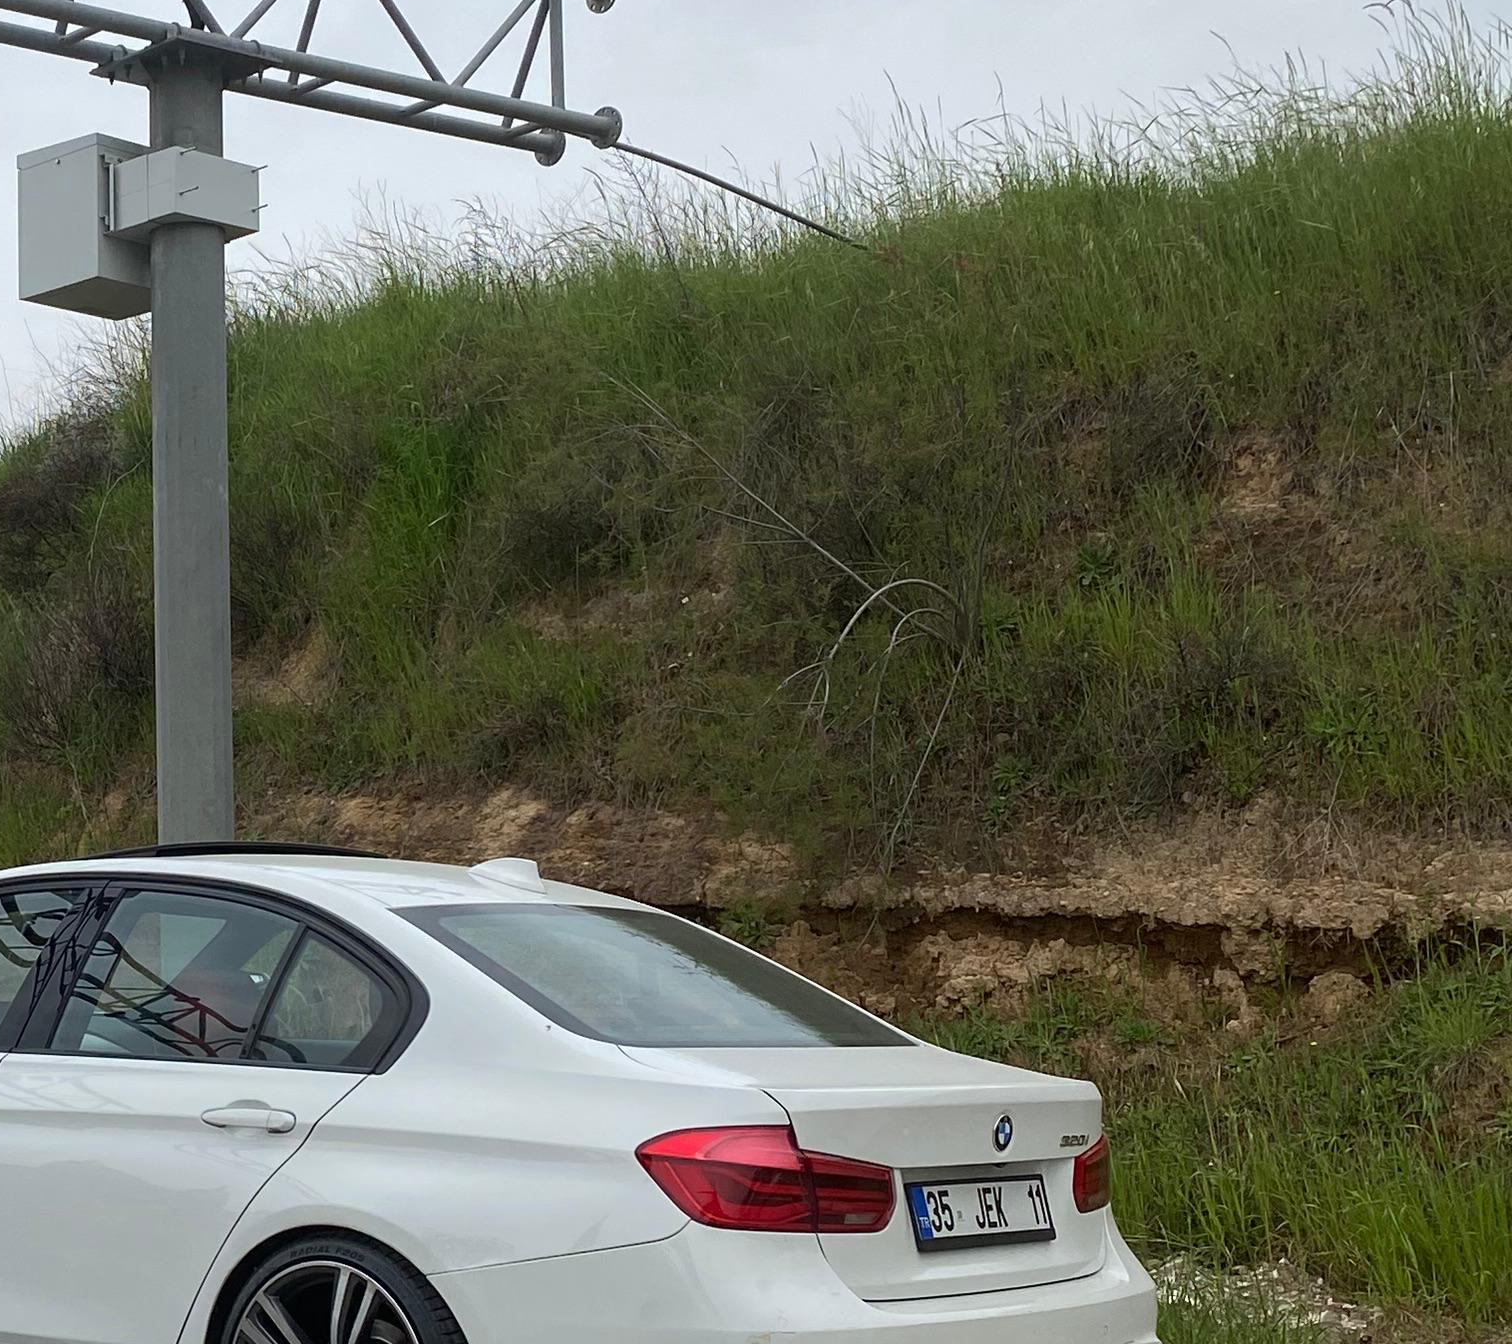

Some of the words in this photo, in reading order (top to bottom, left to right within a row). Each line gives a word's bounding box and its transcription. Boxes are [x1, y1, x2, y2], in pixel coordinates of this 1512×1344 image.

[926, 1187, 955, 1233] 35
[975, 1186, 1009, 1229] JEK
[1027, 1183, 1048, 1225] 11
